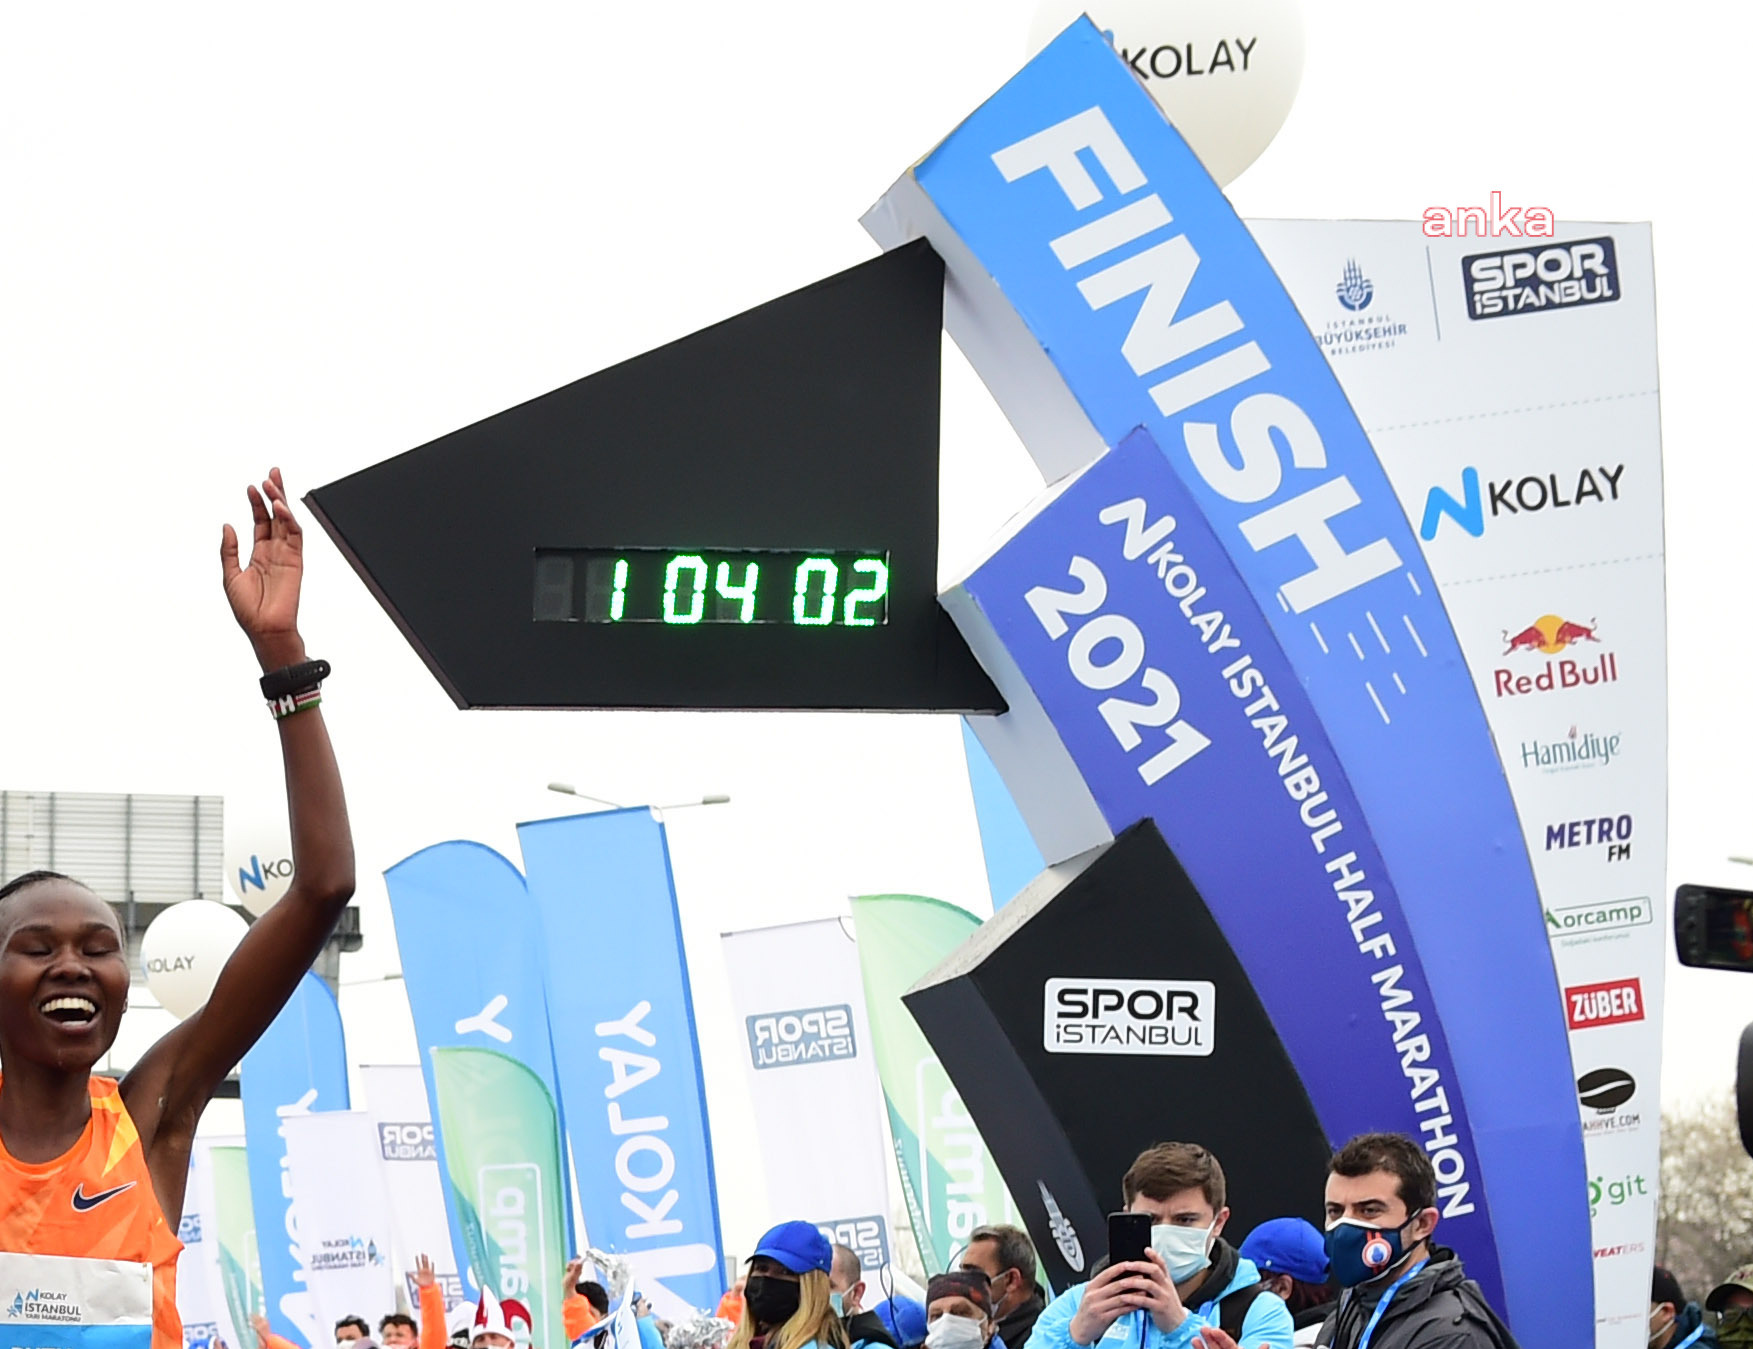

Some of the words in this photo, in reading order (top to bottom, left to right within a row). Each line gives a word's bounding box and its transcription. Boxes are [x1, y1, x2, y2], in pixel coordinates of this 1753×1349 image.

[1469, 243, 1611, 293] SPOR
[991, 105, 1404, 615] FINISH
[610, 559, 628, 621] 1
[664, 555, 759, 623] 04
[793, 558, 888, 626] 02
[1024, 556, 1212, 786] 2021
[1494, 661, 1554, 697] Red
[1559, 652, 1618, 688] Bull
[1521, 731, 1622, 767] Hamidiye
[1545, 814, 1633, 850] METRO
[1607, 843, 1632, 862] FM
[1222, 655, 1343, 854] ISTANBUL
[1325, 851, 1397, 960] HALF
[1370, 964, 1475, 1218] MARATHON
[1057, 988, 1202, 1022] SPOR
[1571, 986, 1639, 1022] ZÜBER
